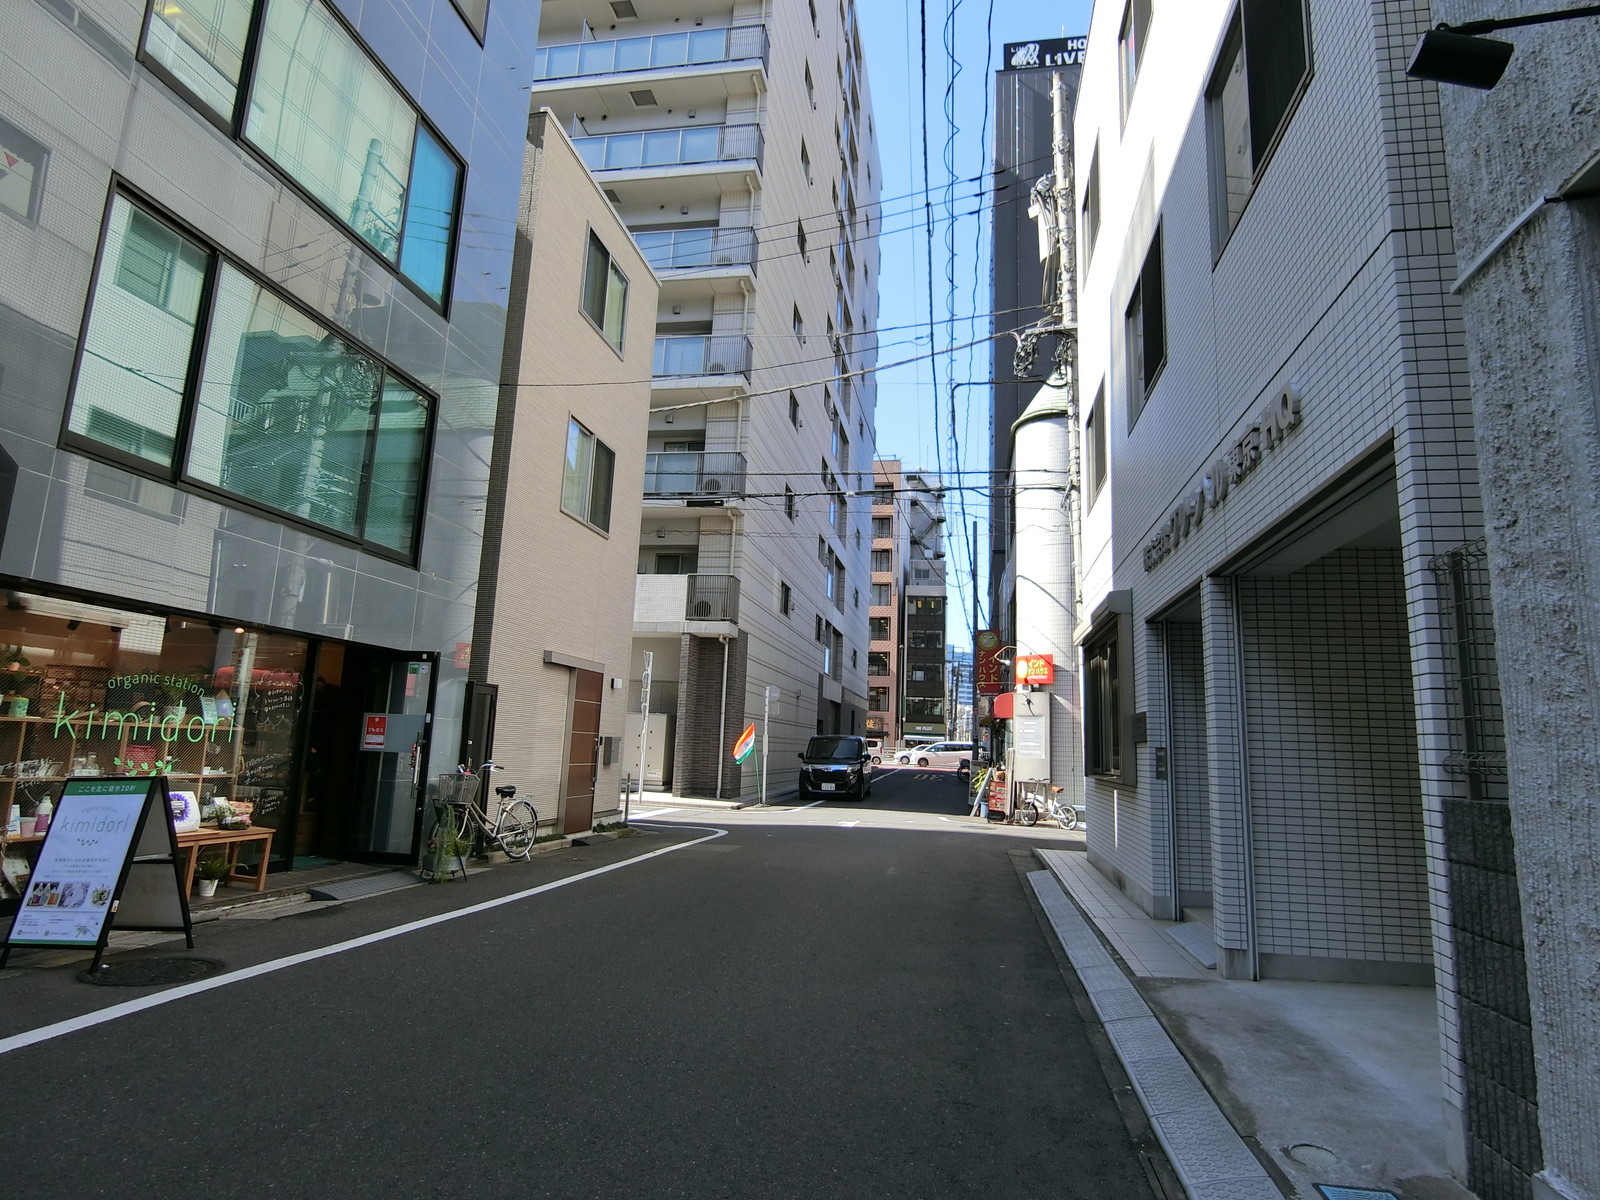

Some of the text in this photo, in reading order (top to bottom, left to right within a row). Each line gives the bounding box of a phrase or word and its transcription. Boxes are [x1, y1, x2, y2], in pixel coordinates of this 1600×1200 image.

[989, 655, 998, 683] インド
[1028, 659, 1045, 668] インド
[107, 671, 205, 697] organic station
[53, 691, 237, 743] kimidori
[60, 813, 131, 833] kimidori
